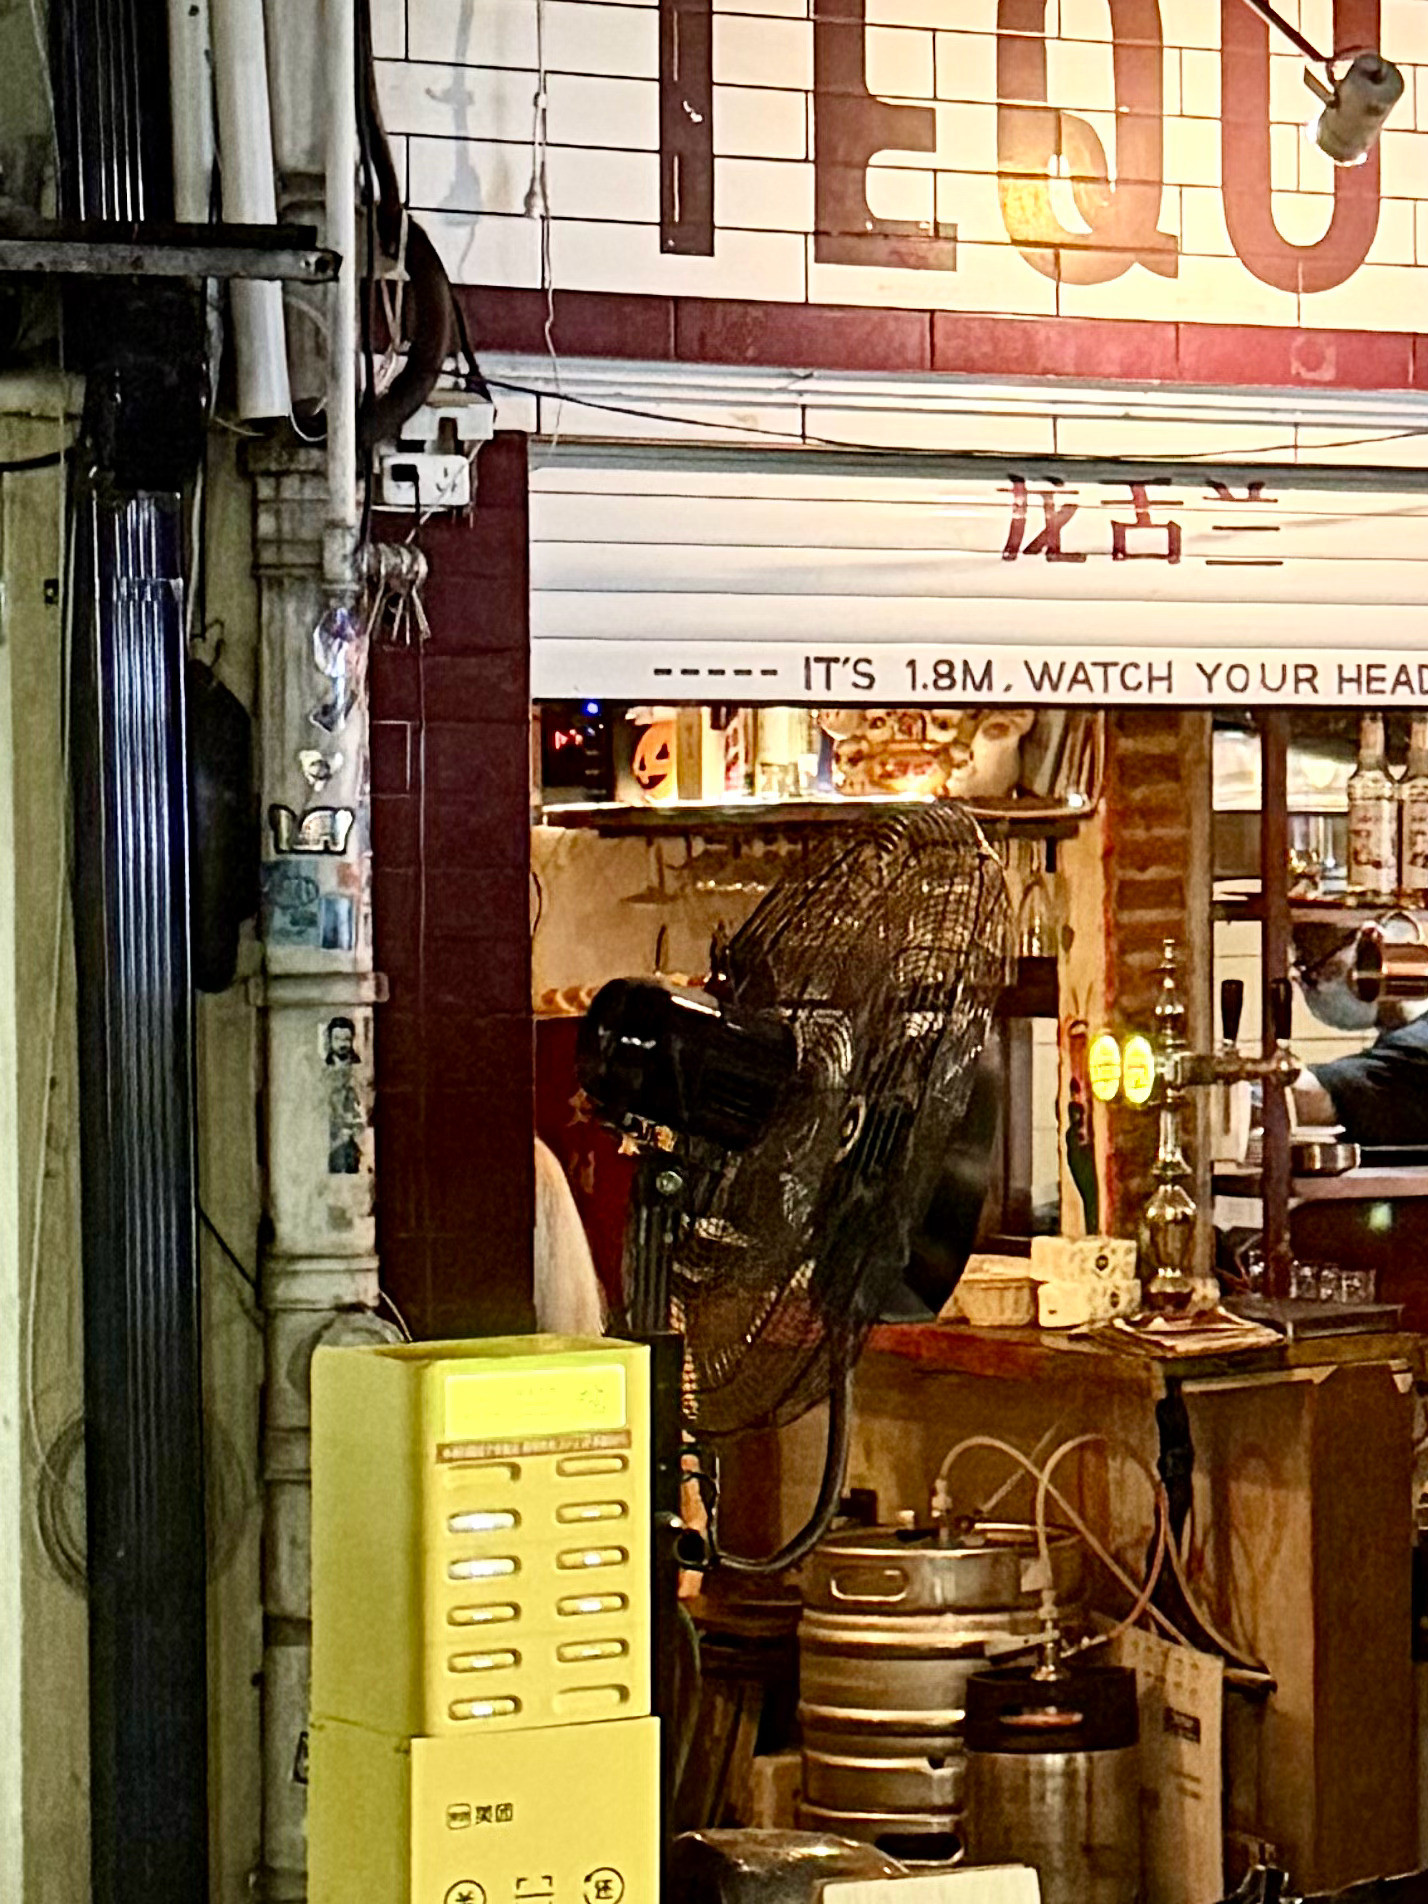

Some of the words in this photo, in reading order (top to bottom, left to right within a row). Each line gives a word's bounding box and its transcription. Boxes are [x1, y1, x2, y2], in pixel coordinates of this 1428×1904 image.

[803, 655, 877, 692] IT'S
[1023, 660, 1174, 695] WATCH
[1195, 662, 1320, 695] YOUR
